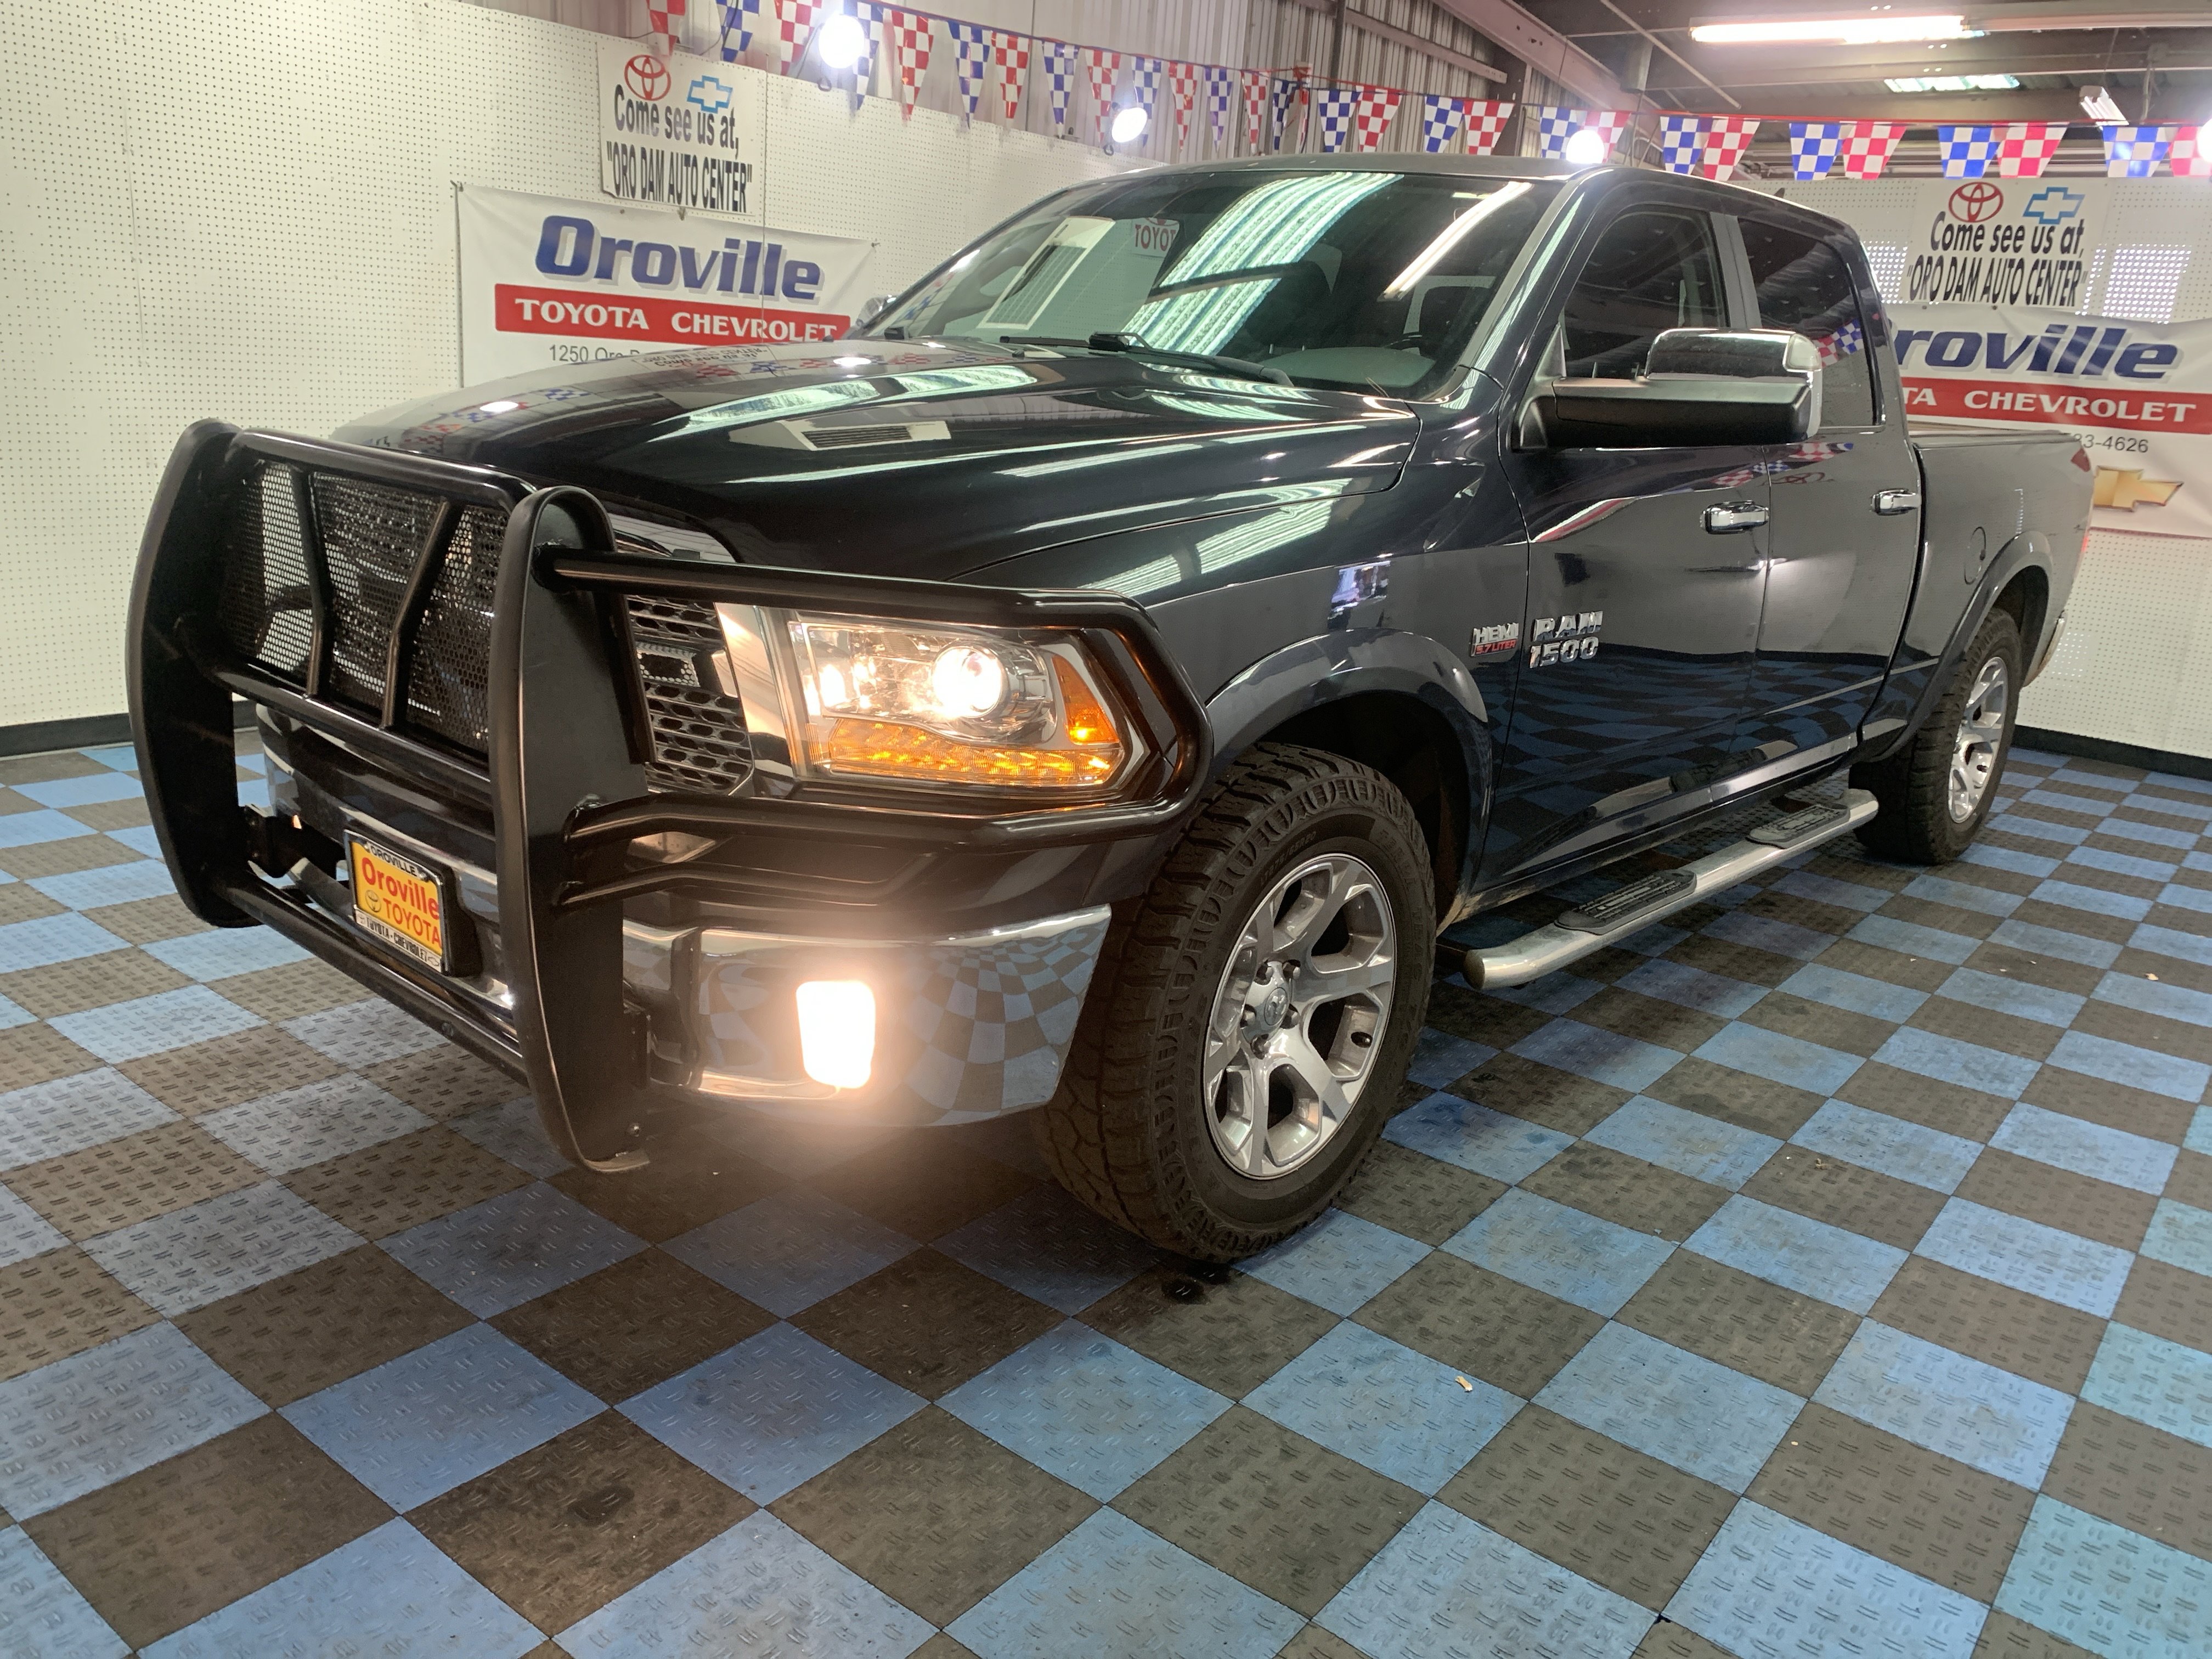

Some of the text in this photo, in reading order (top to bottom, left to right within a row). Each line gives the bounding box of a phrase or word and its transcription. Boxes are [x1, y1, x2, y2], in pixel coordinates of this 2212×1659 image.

[614, 84, 739, 160] Come see us at,
[606, 140, 753, 213] "ORO DAM AUTO CENTER"
[1135, 224, 1176, 251] TOYOT
[1931, 211, 2085, 258] Come see us at,
[535, 215, 822, 301] Oroville
[1906, 254, 2088, 307] "ORO DAM AUTO CENTER"
[515, 298, 837, 342] TOYOTA CHEVROLET
[549, 344, 589, 363] 1250
[1890, 324, 2179, 379] roville
[1964, 390, 2197, 423] CHEVROLET
[1472, 622, 1519, 644] HEMI
[1493, 639, 1517, 651] LITER
[1532, 611, 1603, 642] RAM
[1529, 636, 1599, 668] 1500
[370, 845, 417, 877] OROVILLE
[362, 857, 439, 921] Oroville
[383, 897, 442, 948] TOYOTA
